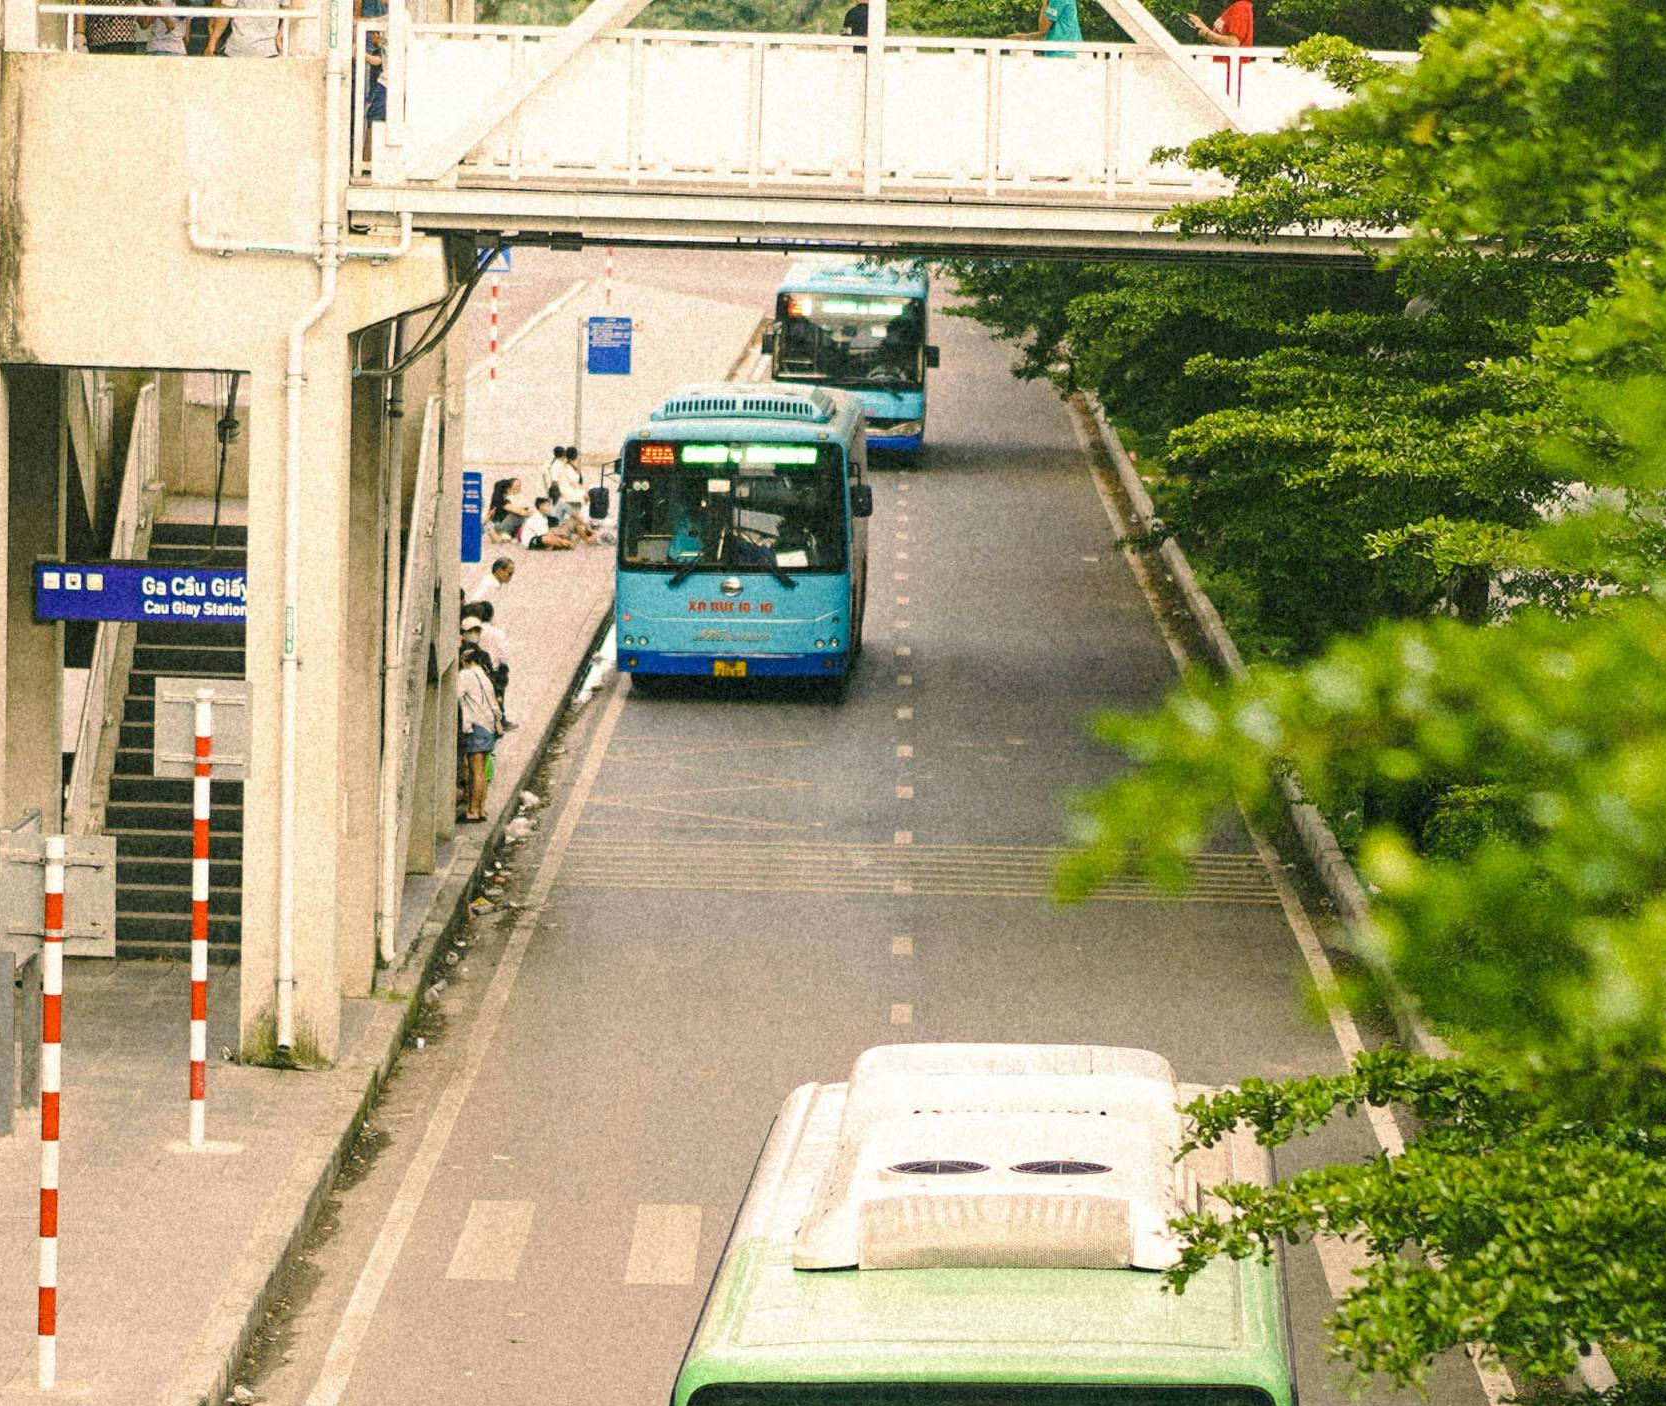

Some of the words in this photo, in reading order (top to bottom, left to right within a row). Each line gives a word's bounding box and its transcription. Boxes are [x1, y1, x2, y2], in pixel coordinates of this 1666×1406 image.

[141, 576, 167, 596] Ga
[144, 600, 169, 615] Cau
[172, 601, 201, 617] Giay
